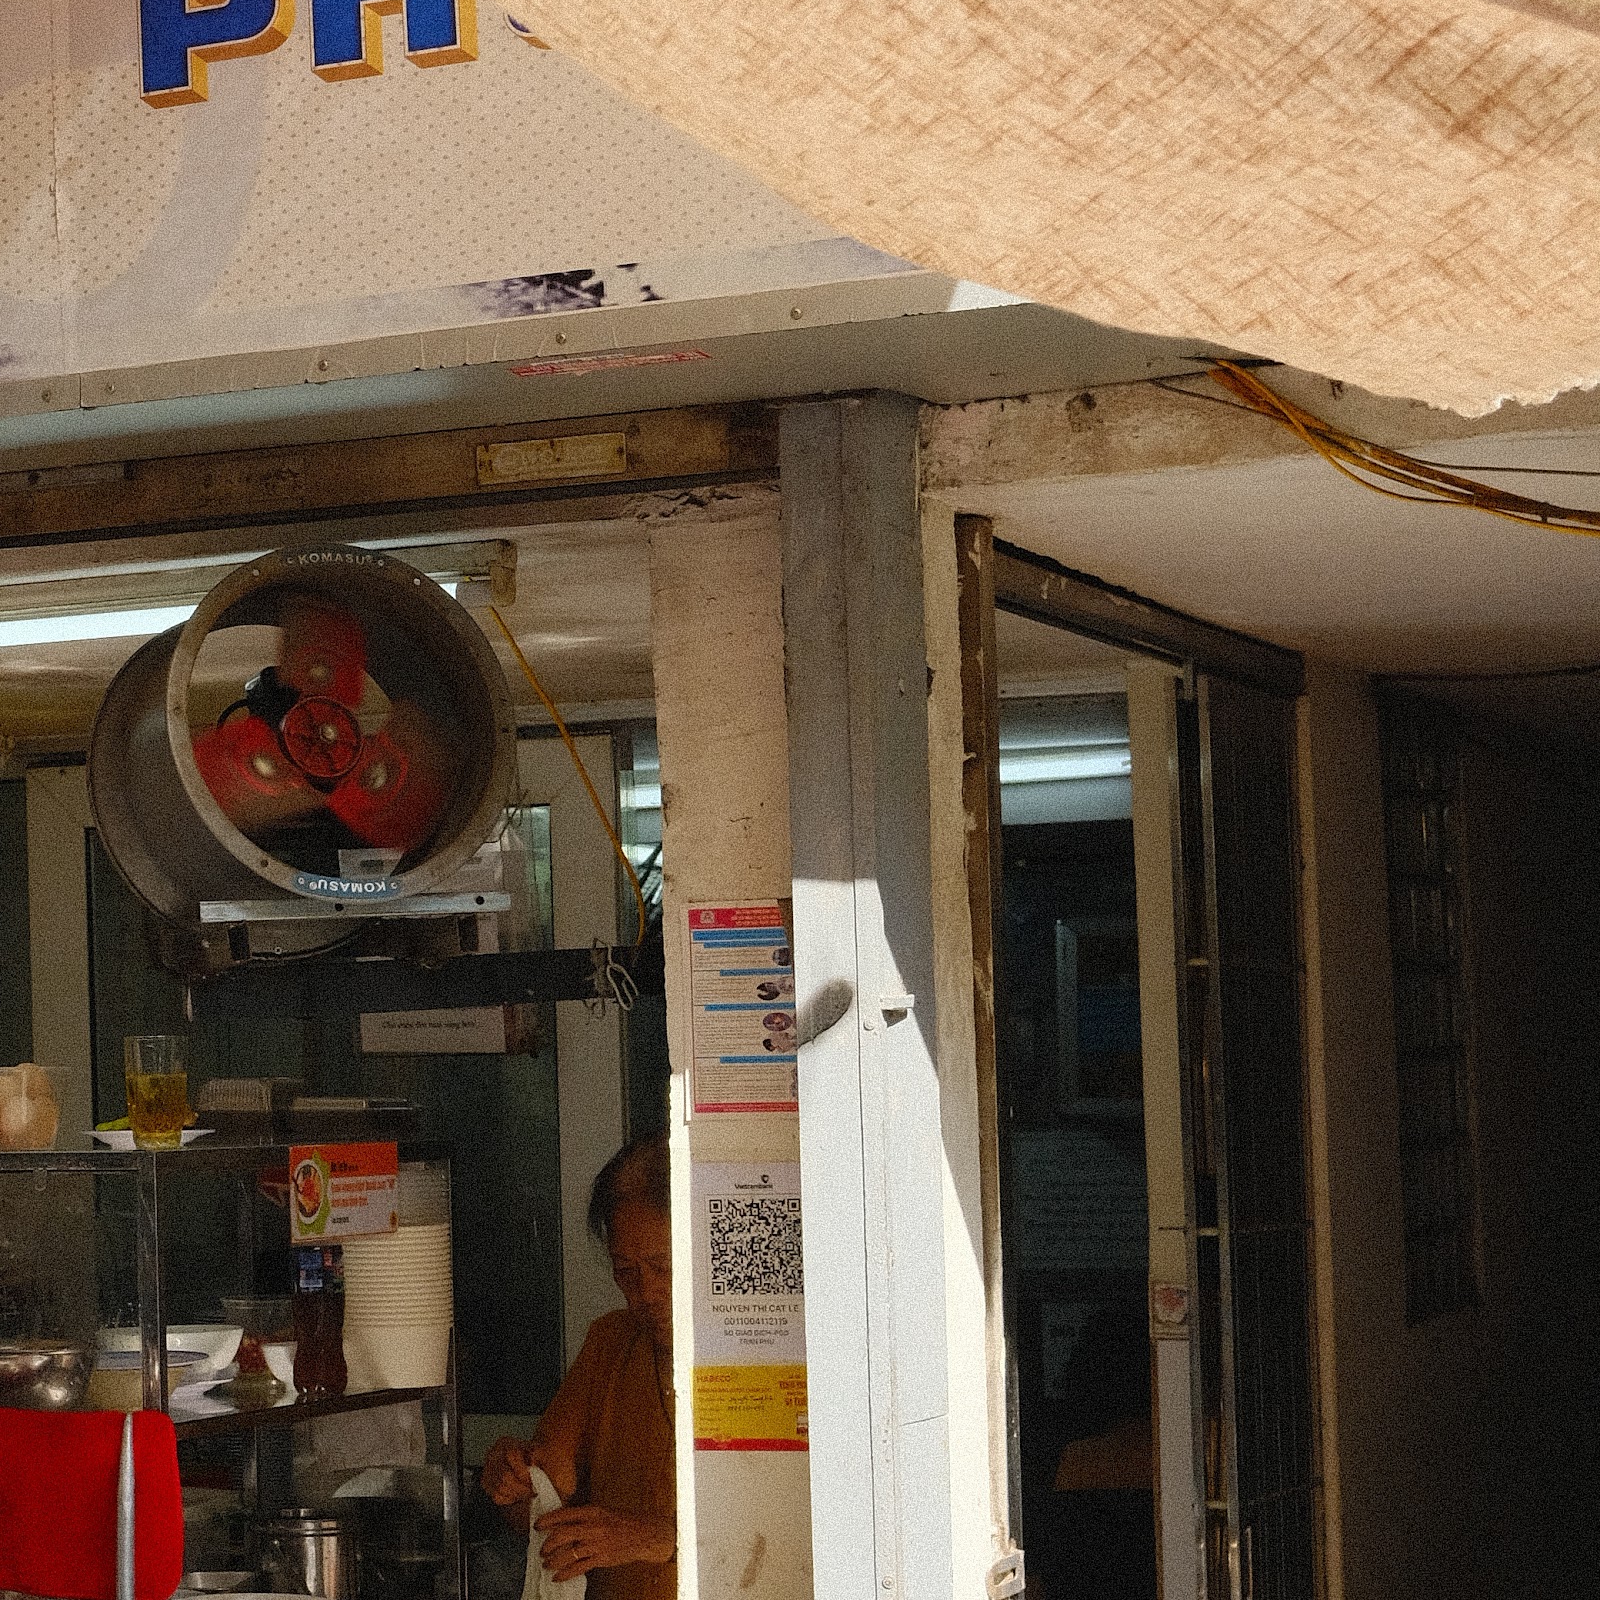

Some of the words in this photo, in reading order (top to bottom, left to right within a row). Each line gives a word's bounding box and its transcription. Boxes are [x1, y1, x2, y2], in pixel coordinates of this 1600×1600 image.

[712, 1304, 750, 1313] NGUYEN
[752, 1304, 767, 1312] THI
[769, 1304, 786, 1312] CAT
